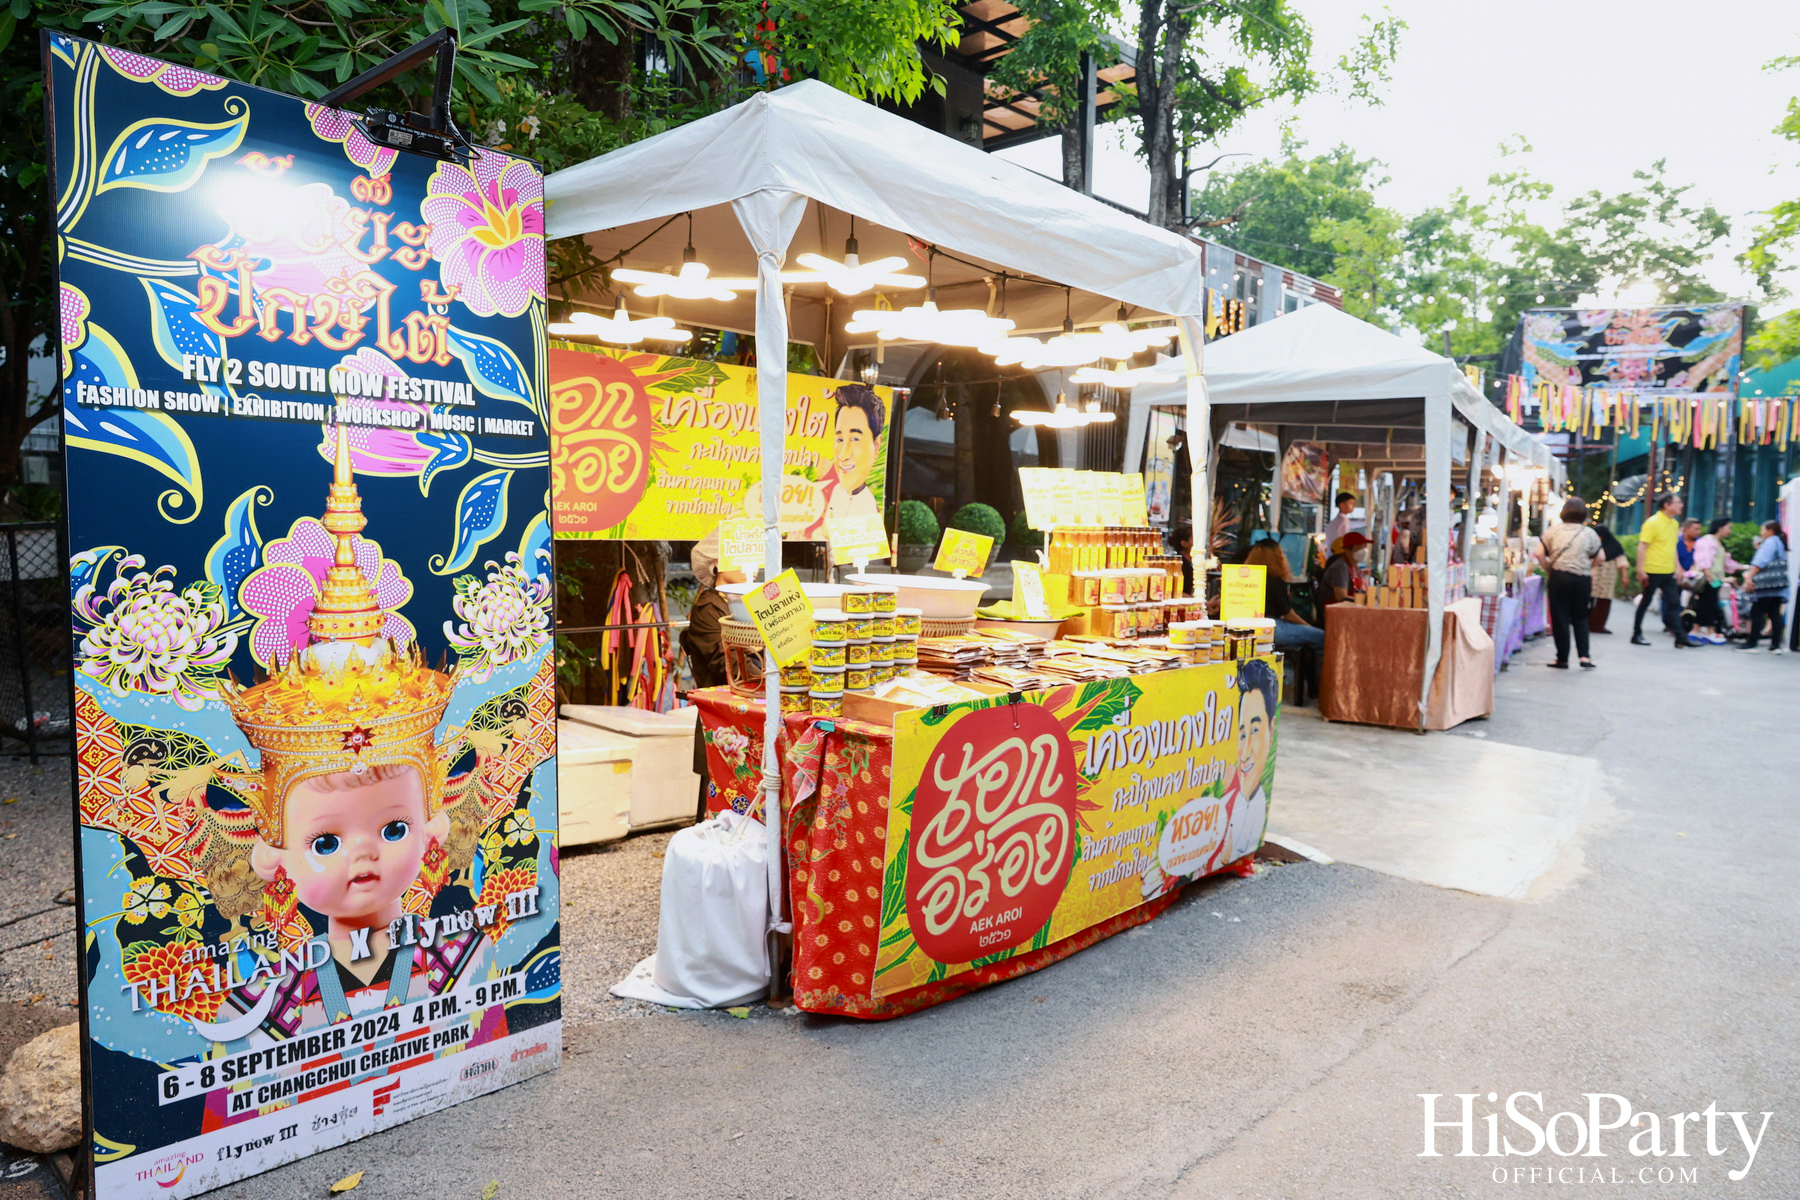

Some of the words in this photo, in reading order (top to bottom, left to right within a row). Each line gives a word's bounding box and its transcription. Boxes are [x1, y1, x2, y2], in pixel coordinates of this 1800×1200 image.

[183, 353, 220, 383] FLY
[229, 358, 243, 385] 2
[248, 360, 326, 393] SOUTH
[330, 370, 384, 398] NOW
[388, 374, 476, 406] FESTIVAL
[77, 382, 160, 410] FASHION
[164, 391, 220, 414] SHOW
[233, 399, 325, 422] EXHIBITION
[336, 404, 421, 429] WORKSHOP
[430, 412, 476, 433] MUSIC
[484, 416, 535, 437] MARKET
[656, 463, 743, 496] สินค้าคุณภาพ
[552, 501, 571, 512] AEK
[572, 501, 598, 512] AROI
[754, 589, 801, 621] ไตปลาแห้ง
[1085, 673, 1237, 776] เครื่องแกงใต้
[1112, 760, 1186, 813] กะปิกุ้งเคย
[1186, 755, 1227, 790] ไตปลา
[1081, 820, 1159, 863] สินค้าคุณภาพ
[1170, 803, 1221, 844] หรอย!
[969, 917, 994, 935] AEK
[995, 906, 1023, 927] AROI
[120, 939, 331, 1014] THAILAND
[386, 902, 497, 951] flynow
[182, 928, 278, 965] amazing
[163, 1075, 180, 1101] 6
[199, 1066, 217, 1089] 8
[221, 1026, 347, 1083] SEPTEMBER
[350, 1011, 402, 1044] 2024
[412, 1006, 426, 1027] 4
[429, 996, 463, 1021] P.M.
[475, 985, 488, 1008] 9
[490, 976, 523, 1003] P.M.
[232, 1092, 255, 1114] AT
[257, 1058, 358, 1106] CHANGCHUI
[360, 1036, 431, 1077] CREATIVE
[432, 1023, 471, 1051] PARK
[135, 1153, 204, 1182] THAILAND
[153, 1151, 187, 1167] amazing
[216, 1133, 276, 1163] flynow
